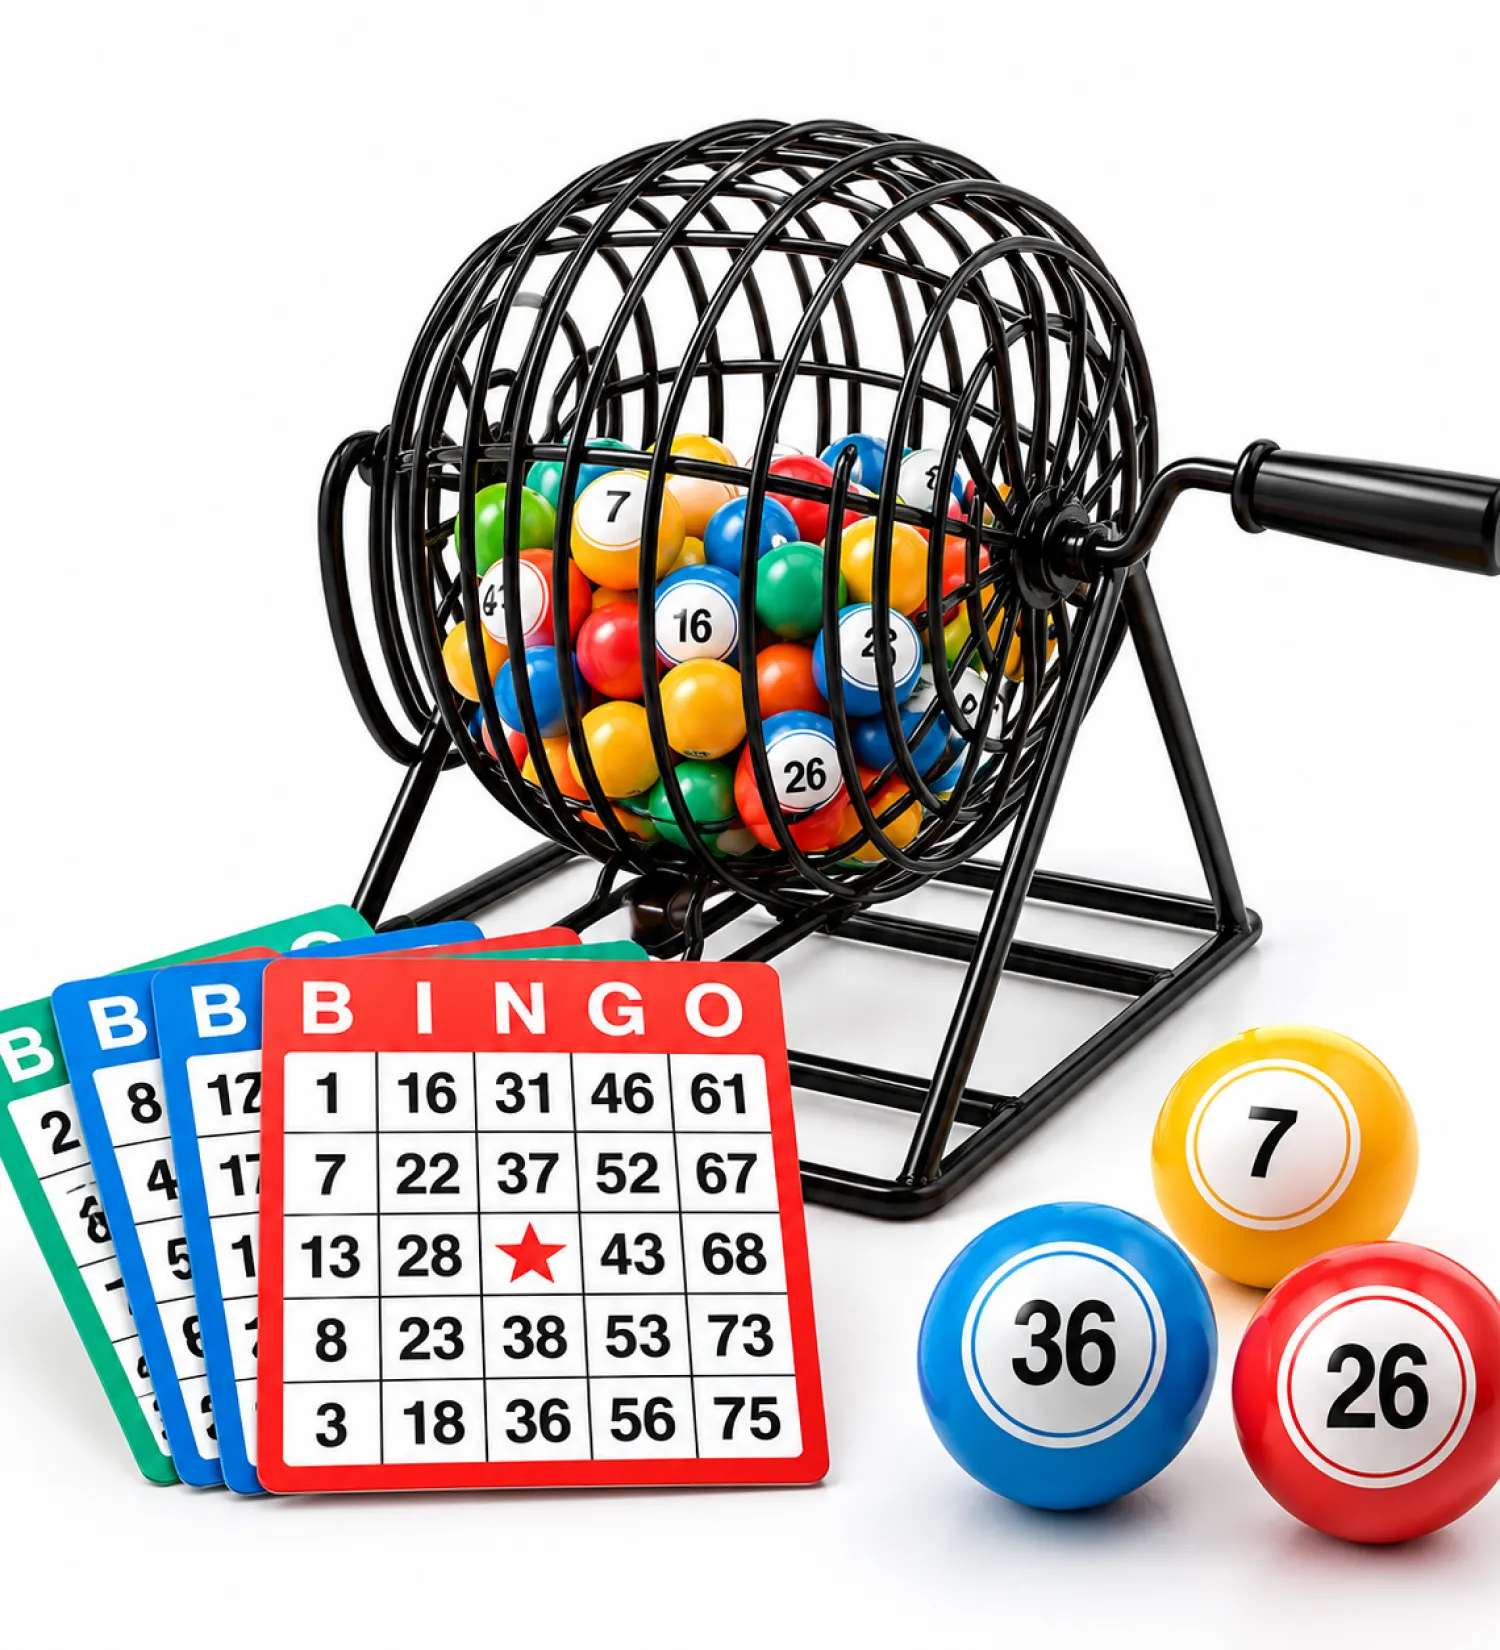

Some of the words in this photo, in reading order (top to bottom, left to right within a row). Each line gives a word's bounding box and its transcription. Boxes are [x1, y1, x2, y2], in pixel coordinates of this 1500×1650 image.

[607, 490, 631, 522] 7
[673, 608, 712, 643] 16
[783, 757, 826, 793] 26
[89, 996, 146, 1050] B
[192, 984, 246, 1037] B
[0, 1027, 54, 1082] B
[128, 1083, 162, 1123] 8
[317, 1073, 337, 1113] 1
[399, 1072, 456, 1113] 16
[496, 1072, 549, 1113] 31
[592, 1073, 654, 1113] 46
[691, 1073, 745, 1114] 61
[41, 1111, 81, 1154] 2
[1249, 1107, 1297, 1178] 7
[147, 1159, 178, 1200] 4
[316, 1154, 345, 1195] 7
[397, 1153, 459, 1194] 22
[498, 1153, 558, 1194] 37
[597, 1153, 659, 1194] 52
[697, 1153, 757, 1194] 67
[168, 1237, 192, 1280] 5
[302, 1235, 360, 1278] 13
[399, 1234, 462, 1277] 28
[601, 1233, 664, 1275] 43
[703, 1233, 766, 1275] 68
[316, 1318, 346, 1362] 8
[400, 1317, 463, 1360] 23
[504, 1316, 567, 1359] 38
[606, 1315, 670, 1358] 53
[708, 1314, 773, 1357] 73
[1012, 1299, 1116, 1386] 36
[1327, 1343, 1428, 1429] 26
[316, 1403, 346, 1447] 3
[404, 1400, 465, 1444] 18
[507, 1398, 570, 1443] 36
[611, 1397, 675, 1441] 56
[714, 1397, 780, 1440] 75
